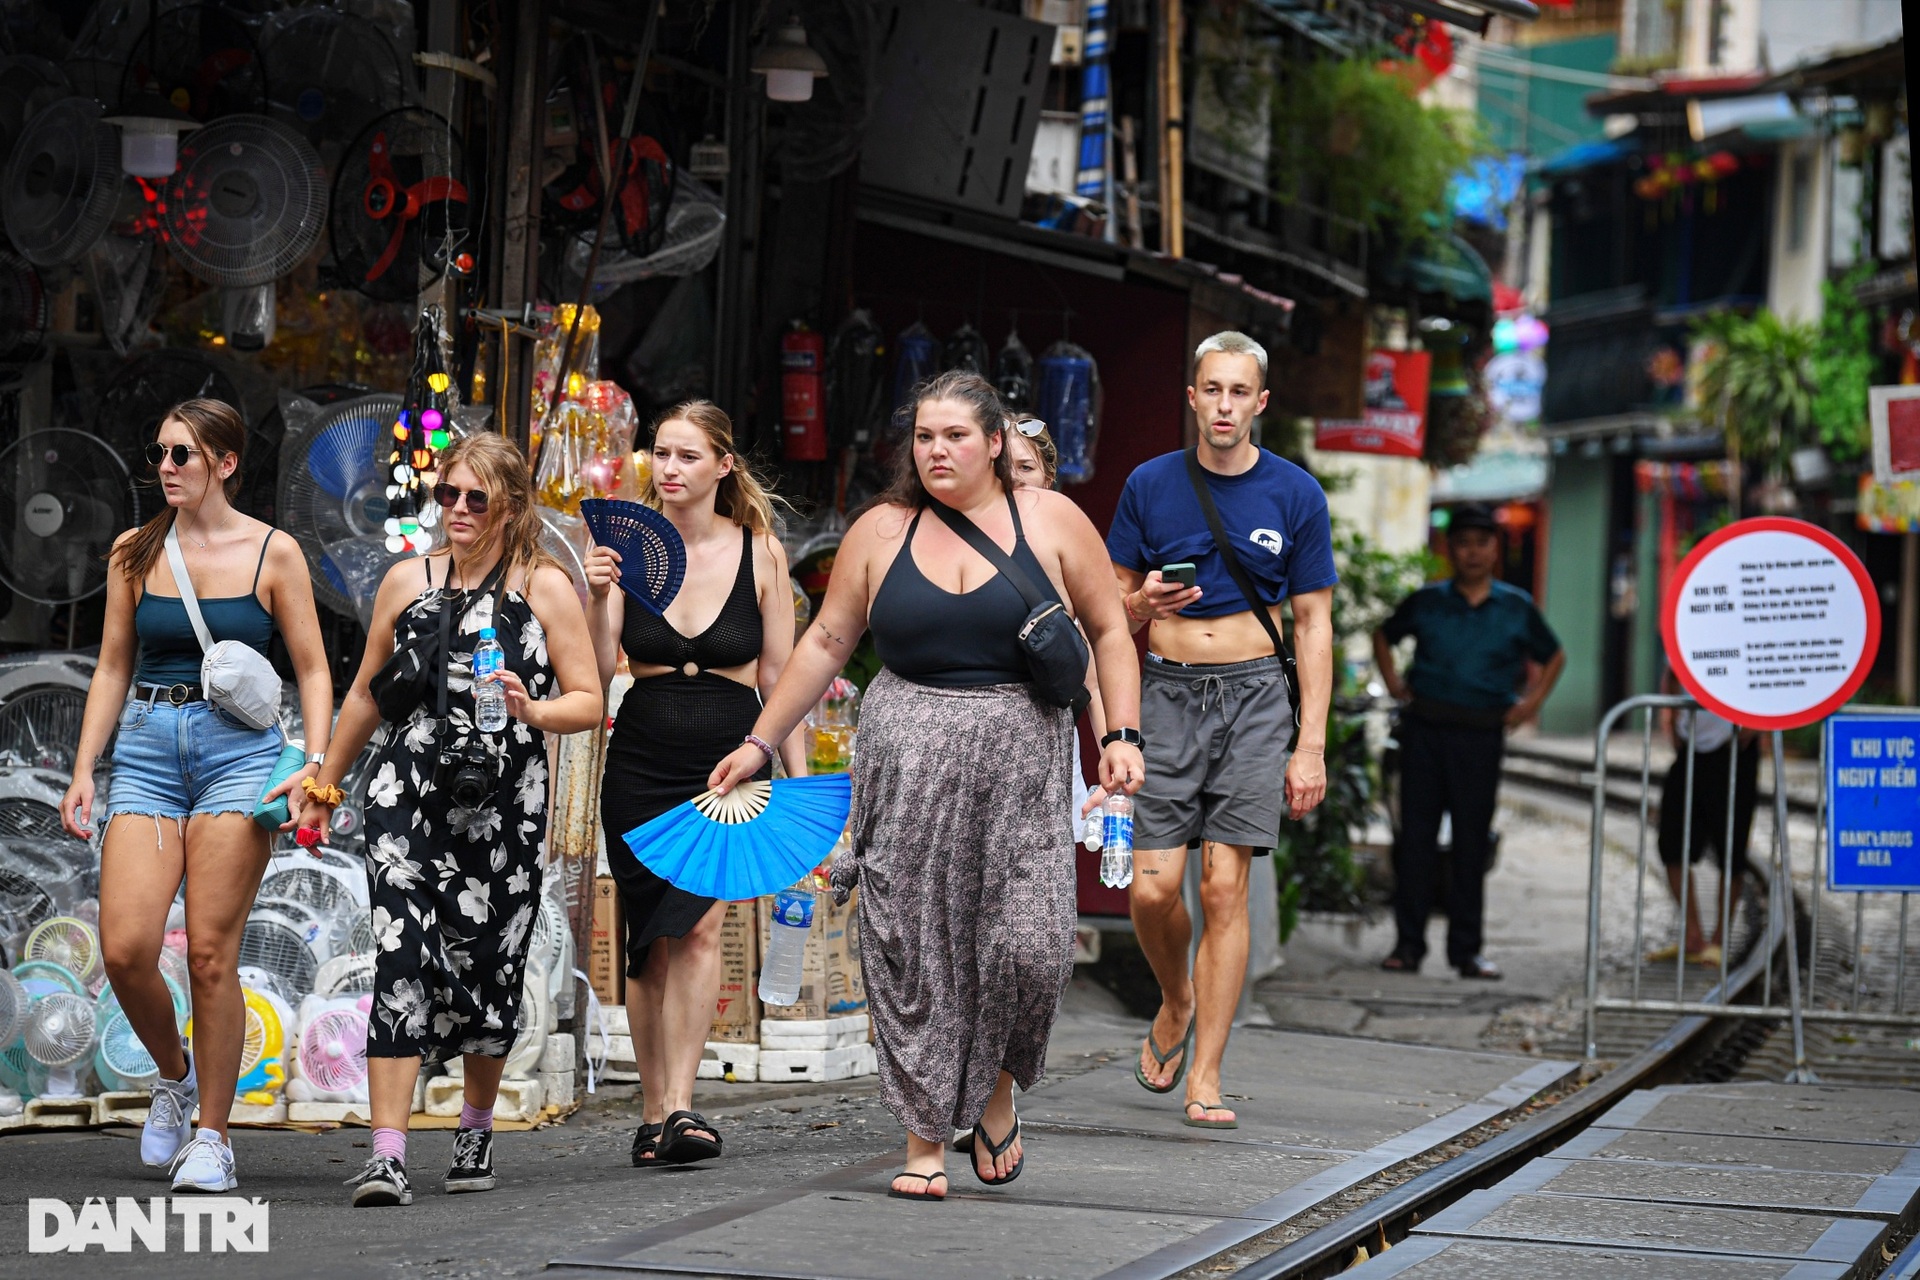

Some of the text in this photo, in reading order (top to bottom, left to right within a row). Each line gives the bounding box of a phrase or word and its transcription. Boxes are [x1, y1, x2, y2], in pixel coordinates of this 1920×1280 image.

[1850, 737, 1882, 758] KHU
[1836, 767, 1877, 788] NGUY
[1857, 849, 1892, 867] AREA
